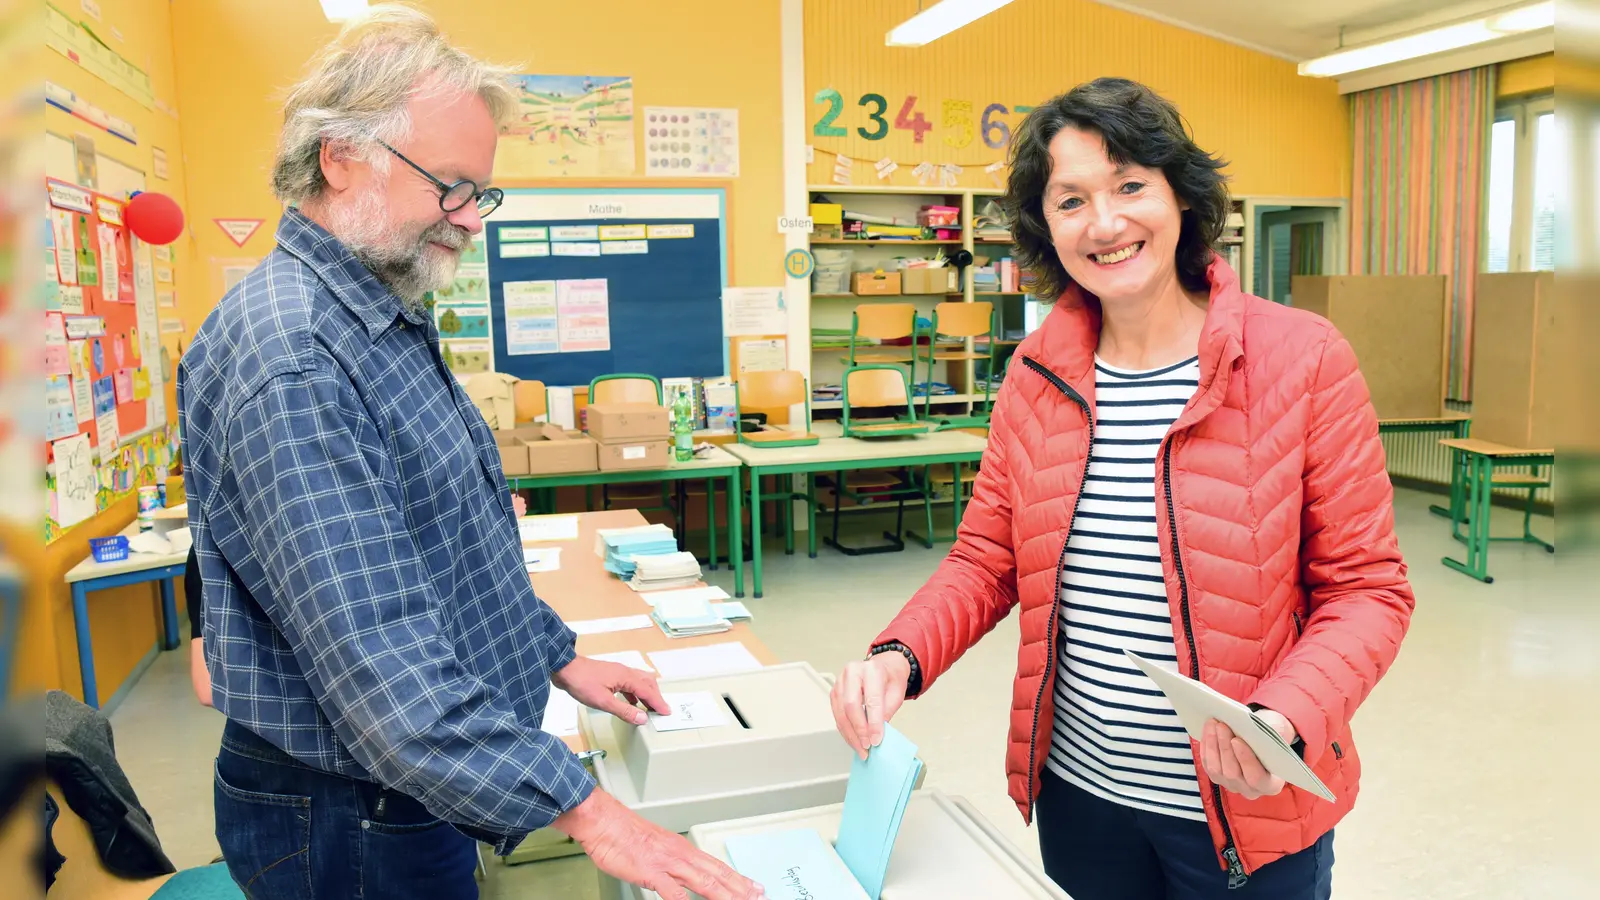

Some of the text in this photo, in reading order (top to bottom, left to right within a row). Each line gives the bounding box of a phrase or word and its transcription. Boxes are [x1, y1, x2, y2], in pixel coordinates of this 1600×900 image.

[814, 88, 1010, 149] 2 3 4 5 6
[588, 204, 622, 214] Mathe
[779, 217, 812, 228] Osten
